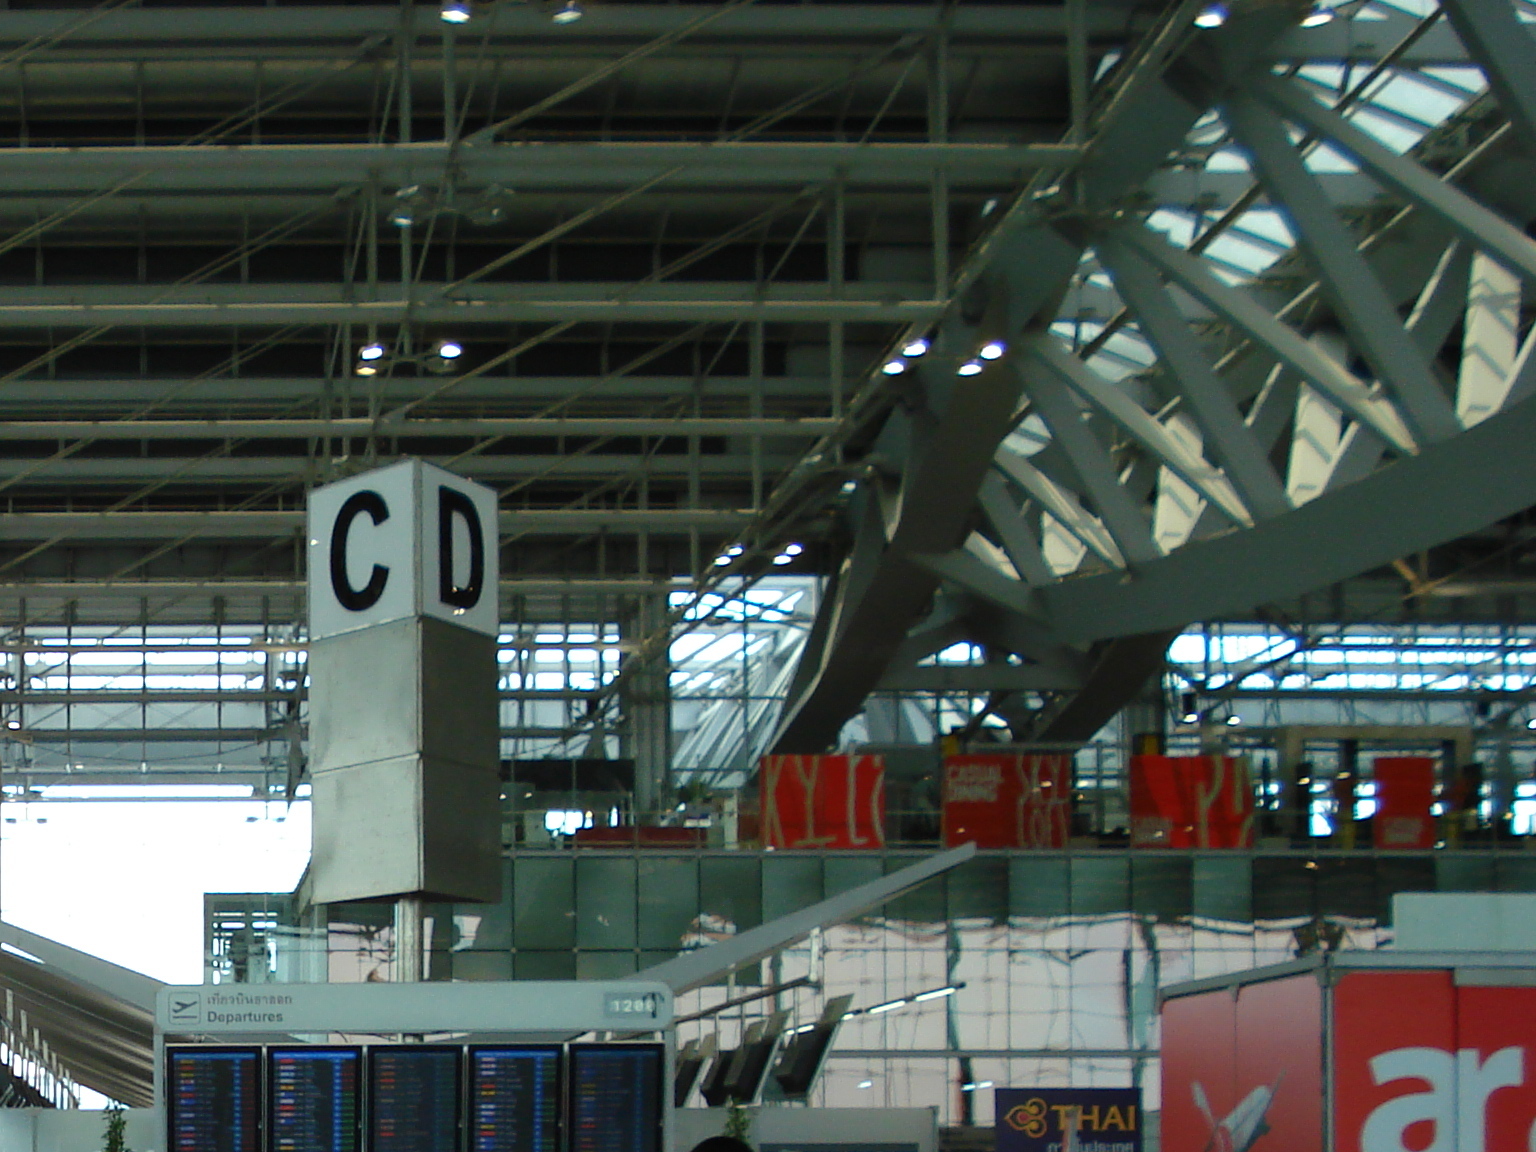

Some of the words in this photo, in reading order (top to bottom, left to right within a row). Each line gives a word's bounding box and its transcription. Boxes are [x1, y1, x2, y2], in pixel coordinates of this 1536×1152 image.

[330, 489, 390, 611] C
[438, 484, 484, 610] D
[207, 1011, 283, 1025] Departures
[1050, 1104, 1137, 1131] THAI
